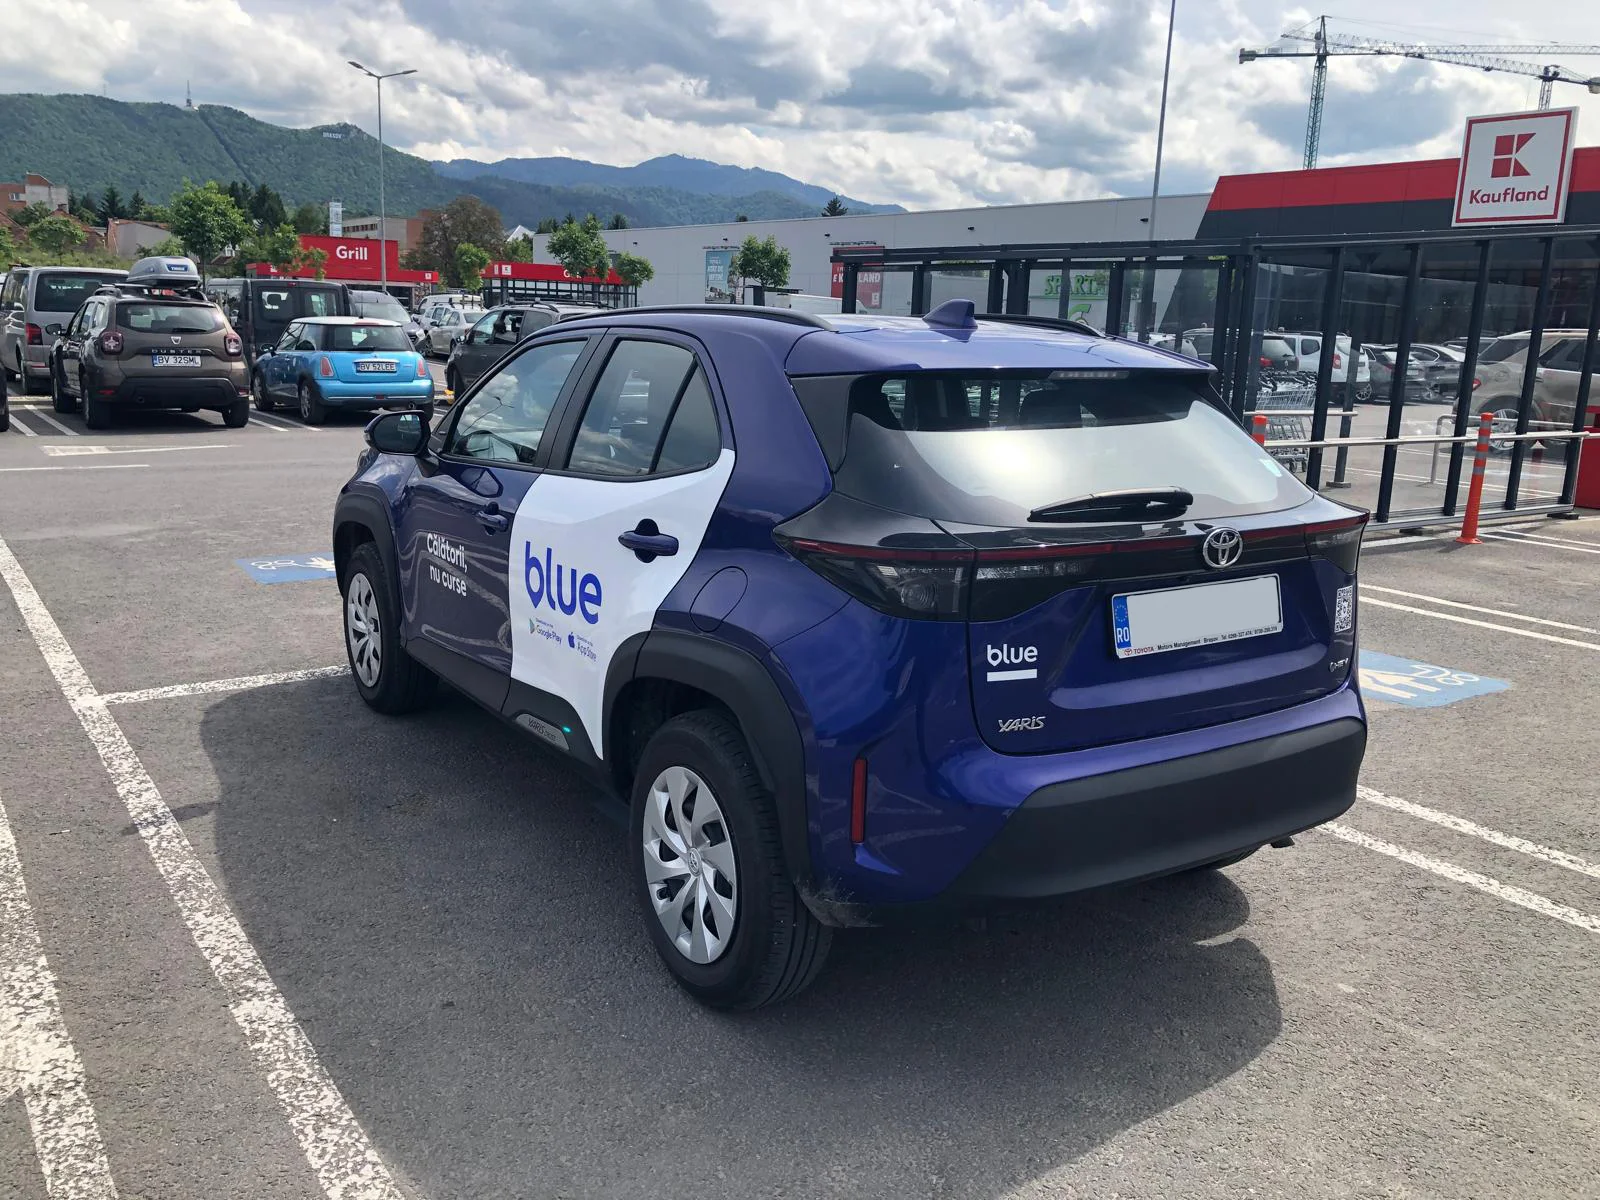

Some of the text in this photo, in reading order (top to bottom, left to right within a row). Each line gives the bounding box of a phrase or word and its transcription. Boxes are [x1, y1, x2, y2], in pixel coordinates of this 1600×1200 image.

[1469, 185, 1549, 204] Kaufland
[336, 246, 368, 260] Grill
[427, 533, 467, 573] Călătorii,
[430, 565, 467, 596] nu curse
[525, 540, 602, 624] blue
[1117, 627, 1130, 643] RO
[987, 644, 1038, 667] blue
[1133, 646, 1154, 655] TOYOTA
[1157, 643, 1173, 651] Motors
[1173, 638, 1201, 649] Management
[528, 718, 546, 735] YARIS
[998, 716, 1046, 732] YARIS
